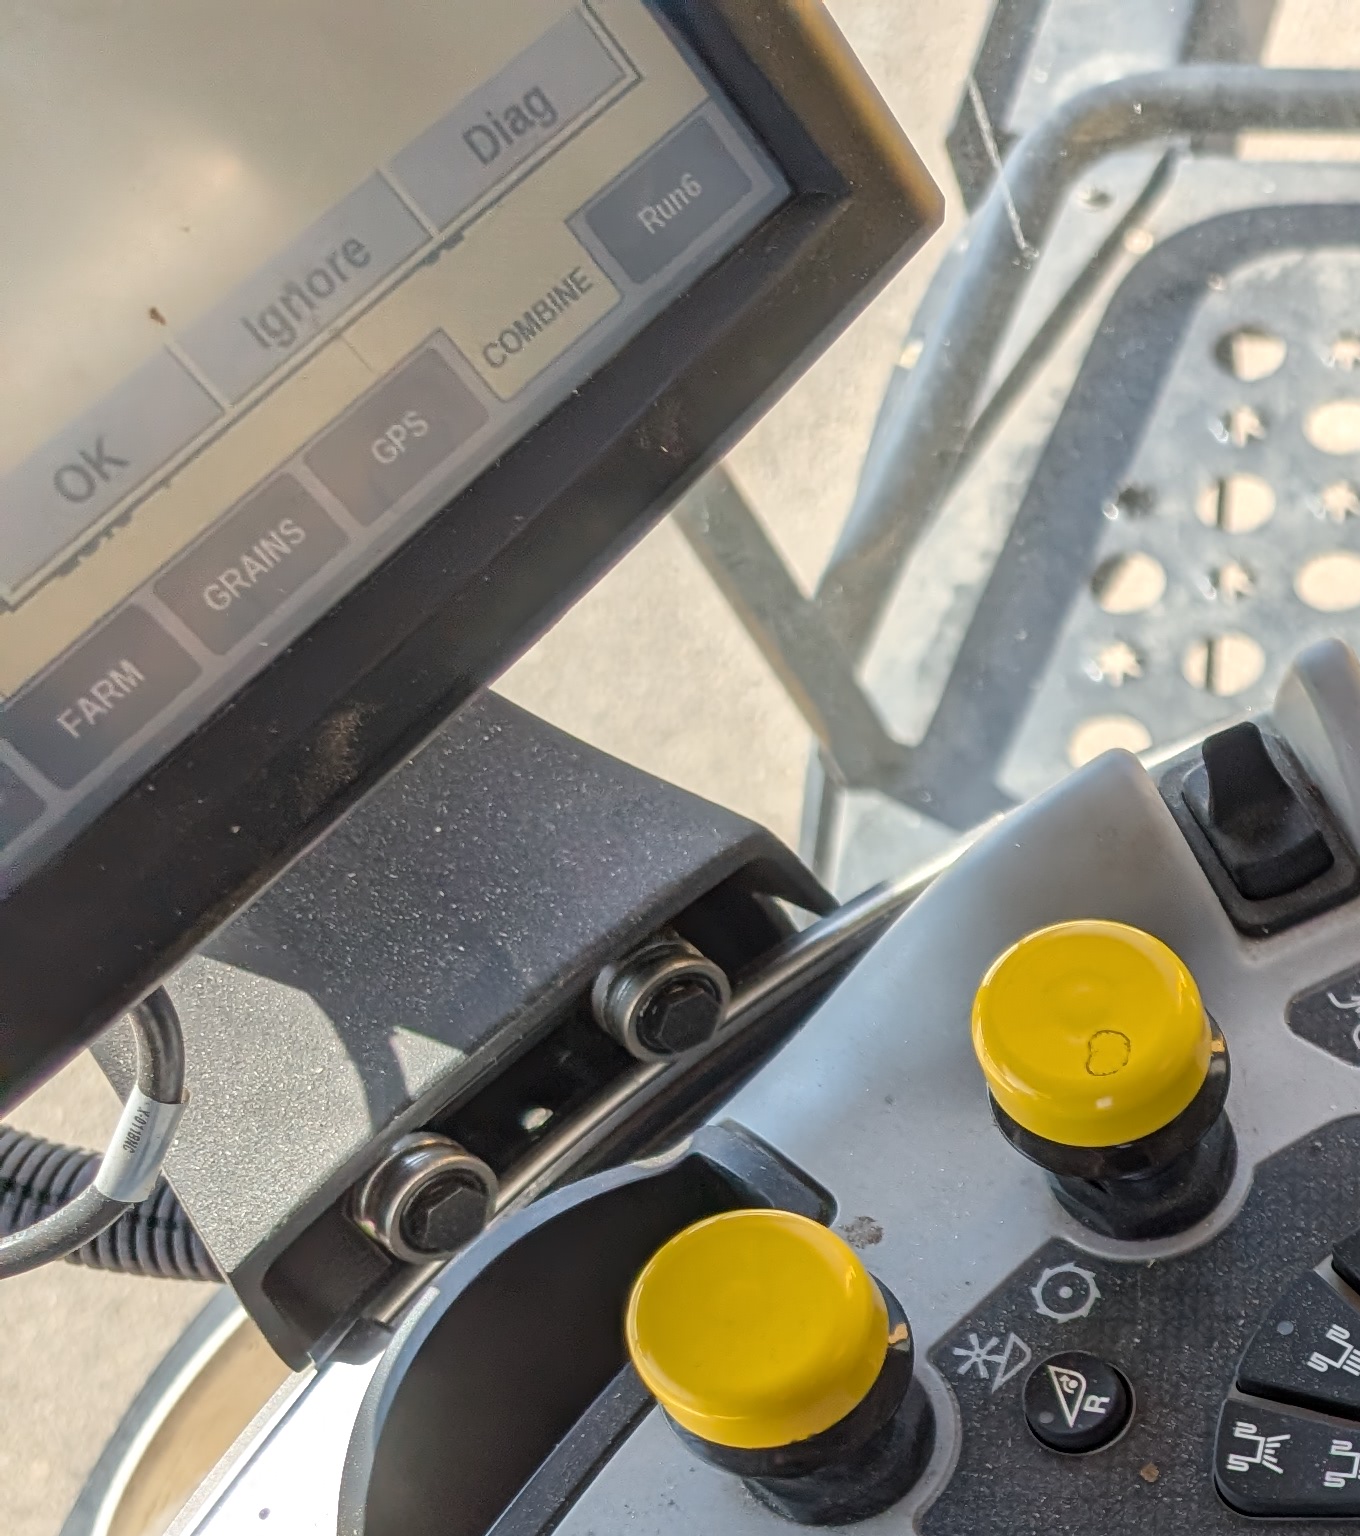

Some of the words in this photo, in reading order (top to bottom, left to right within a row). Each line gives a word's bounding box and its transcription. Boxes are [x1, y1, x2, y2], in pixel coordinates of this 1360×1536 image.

[462, 86, 558, 165] Diag
[637, 173, 702, 234] Run6
[241, 231, 372, 352] Ignore
[482, 266, 594, 369] COMBINE
[54, 435, 130, 503] OK
[371, 410, 429, 464] GPS
[203, 518, 305, 610] GRAINS
[57, 659, 146, 739] FARM
[1083, 1394, 1110, 1414] R
